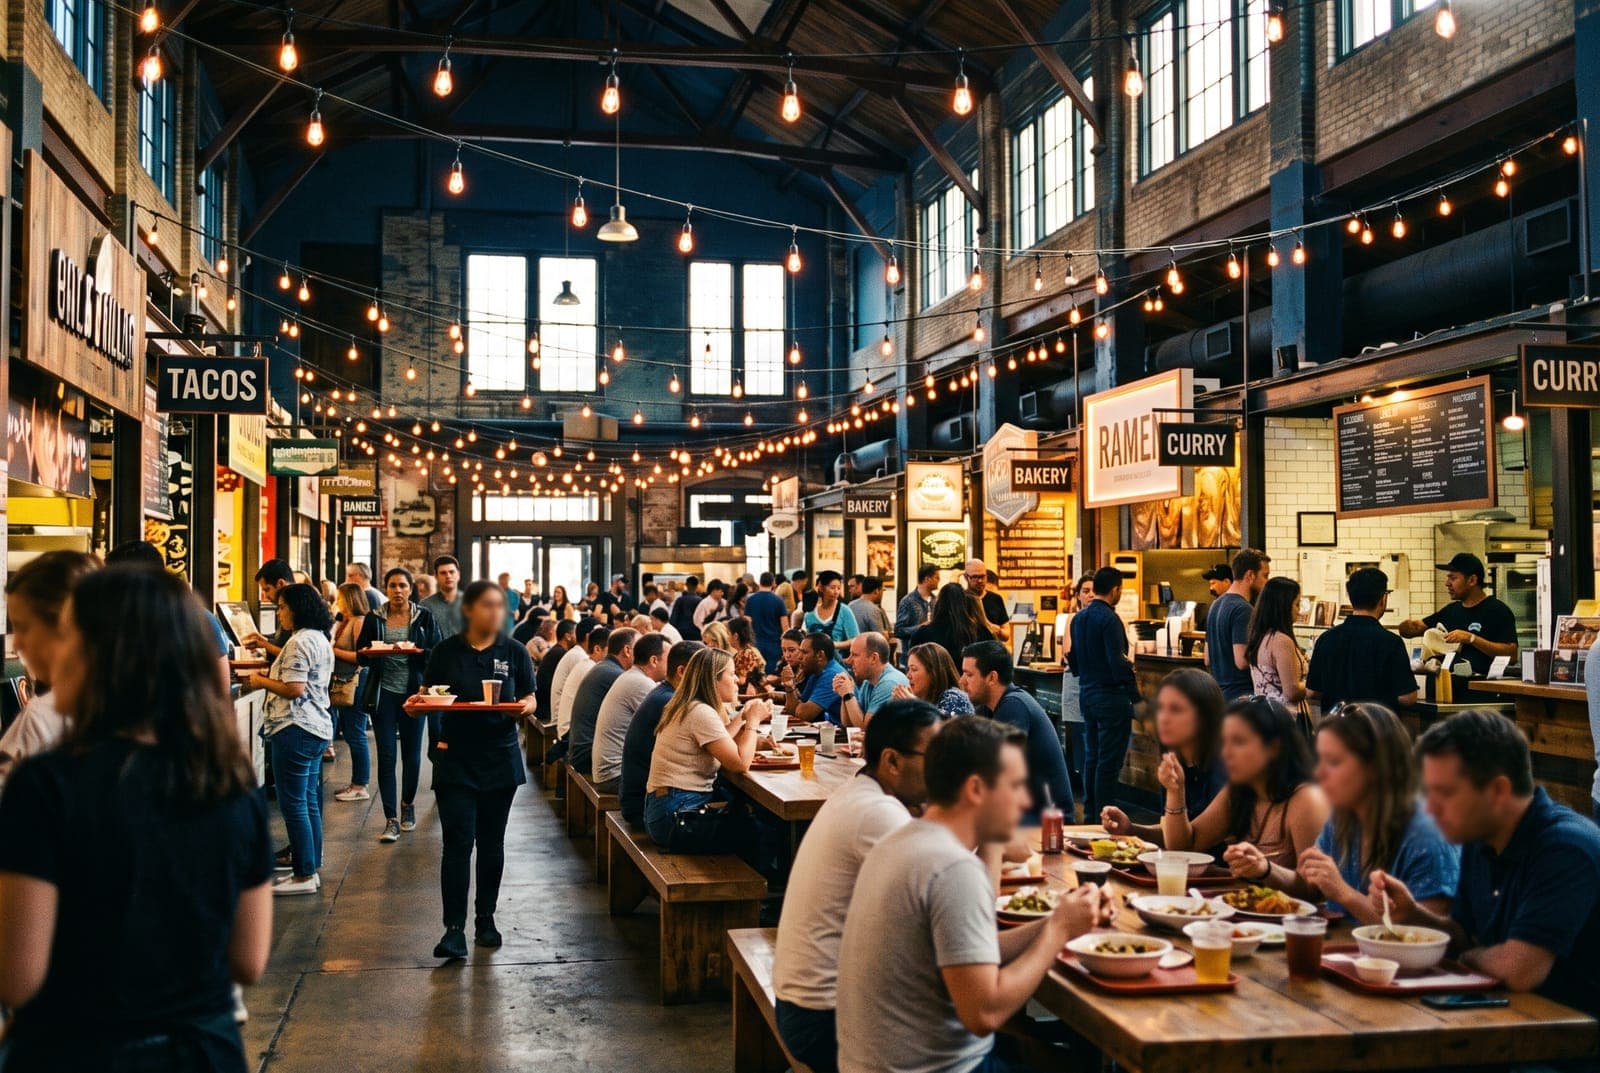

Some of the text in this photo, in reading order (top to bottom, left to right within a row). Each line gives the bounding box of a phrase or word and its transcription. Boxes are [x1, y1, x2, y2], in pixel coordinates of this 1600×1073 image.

[167, 368, 257, 401] TACOS
[1533, 359, 1600, 392] CURR
[1167, 433, 1227, 456] CURRY
[1014, 467, 1069, 484] BAKERY
[847, 500, 889, 513] BAKERY
